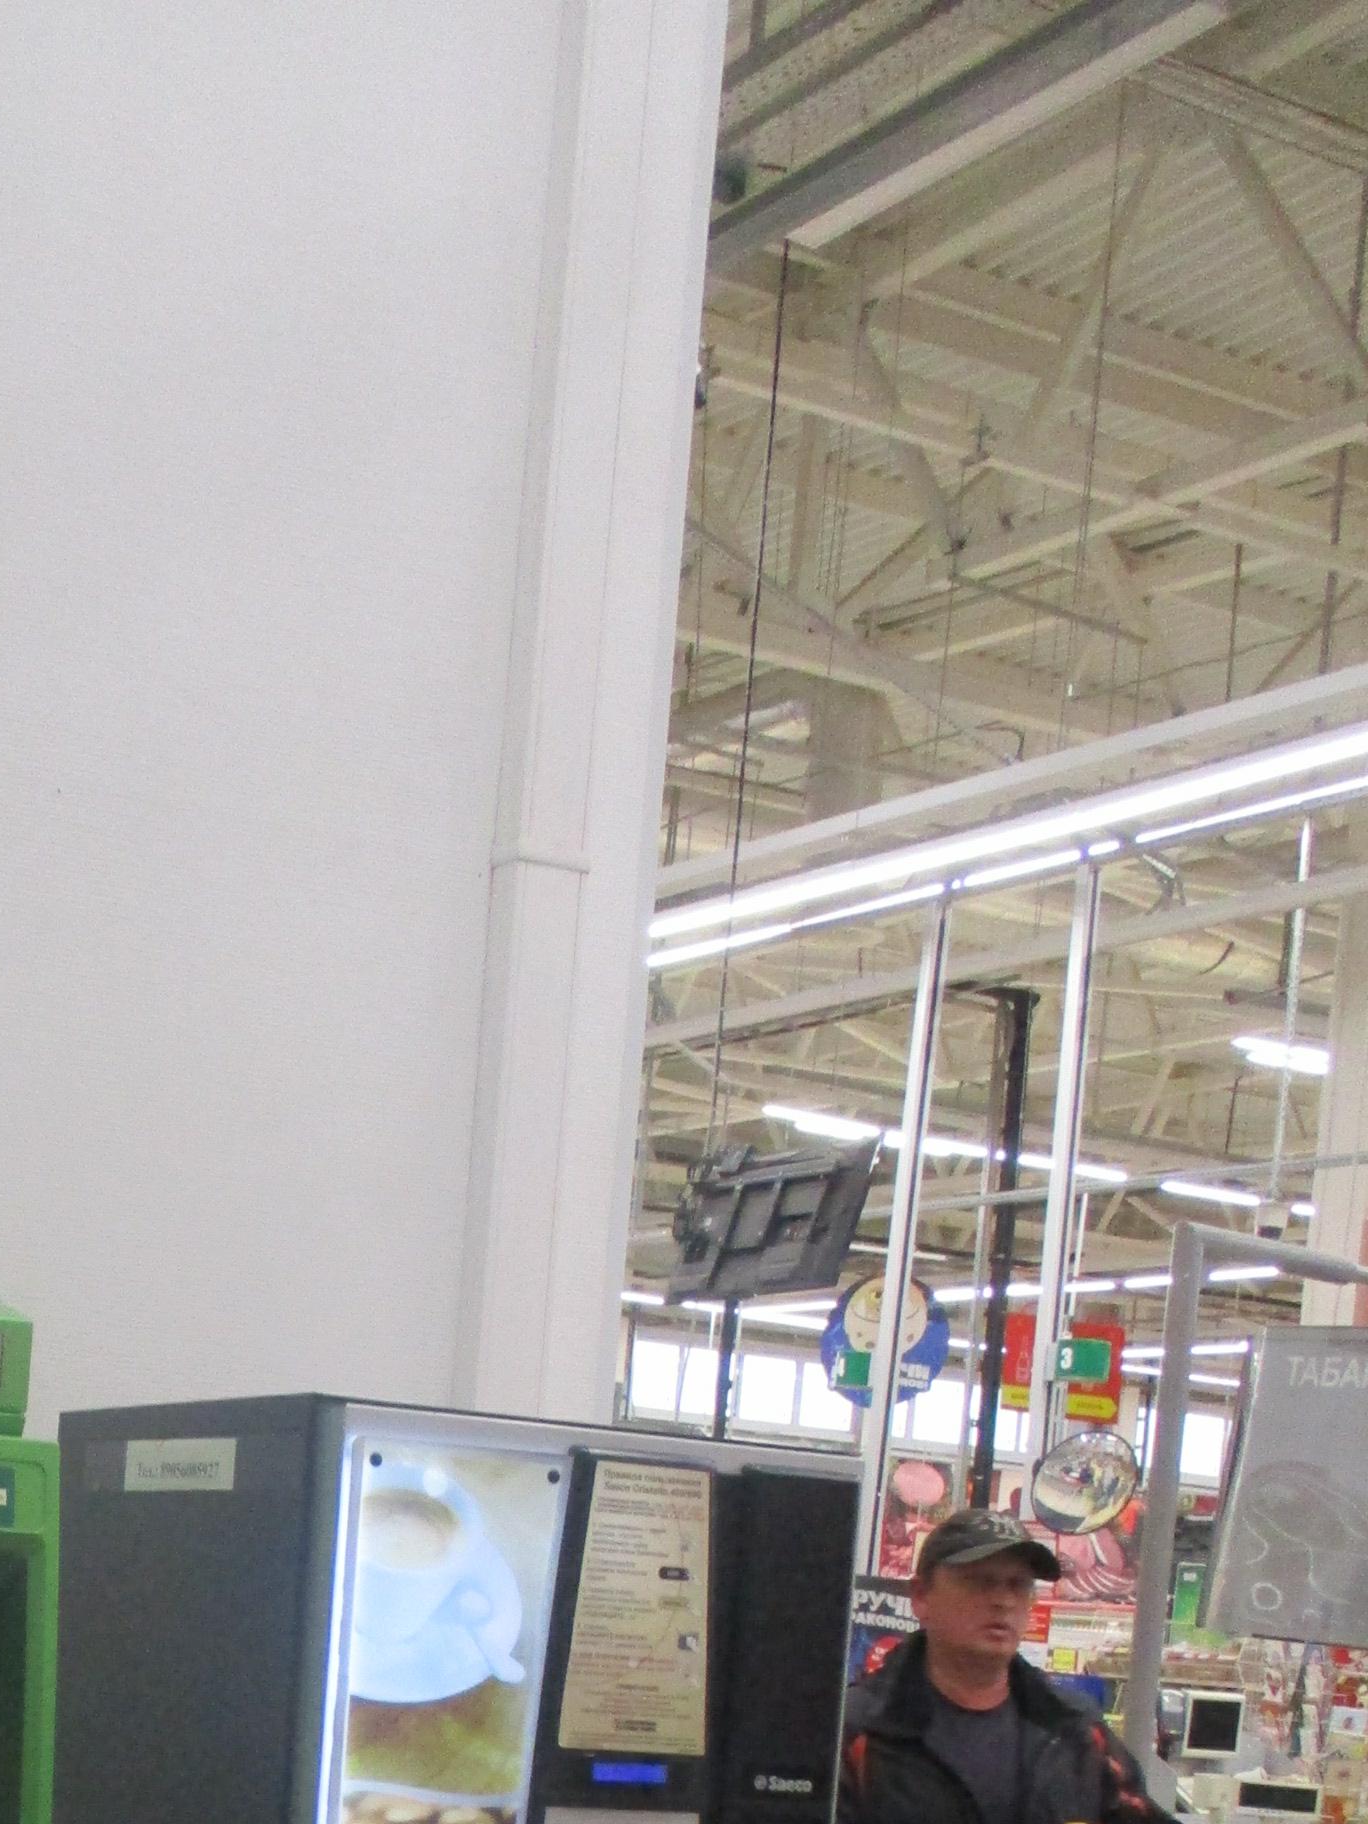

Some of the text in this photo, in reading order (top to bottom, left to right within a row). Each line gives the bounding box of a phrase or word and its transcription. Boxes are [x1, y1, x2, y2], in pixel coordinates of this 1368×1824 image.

[1060, 1347, 1073, 1370] 3
[1287, 1355, 1368, 1389] ТАБА
[768, 1775, 812, 1793] Saeco
